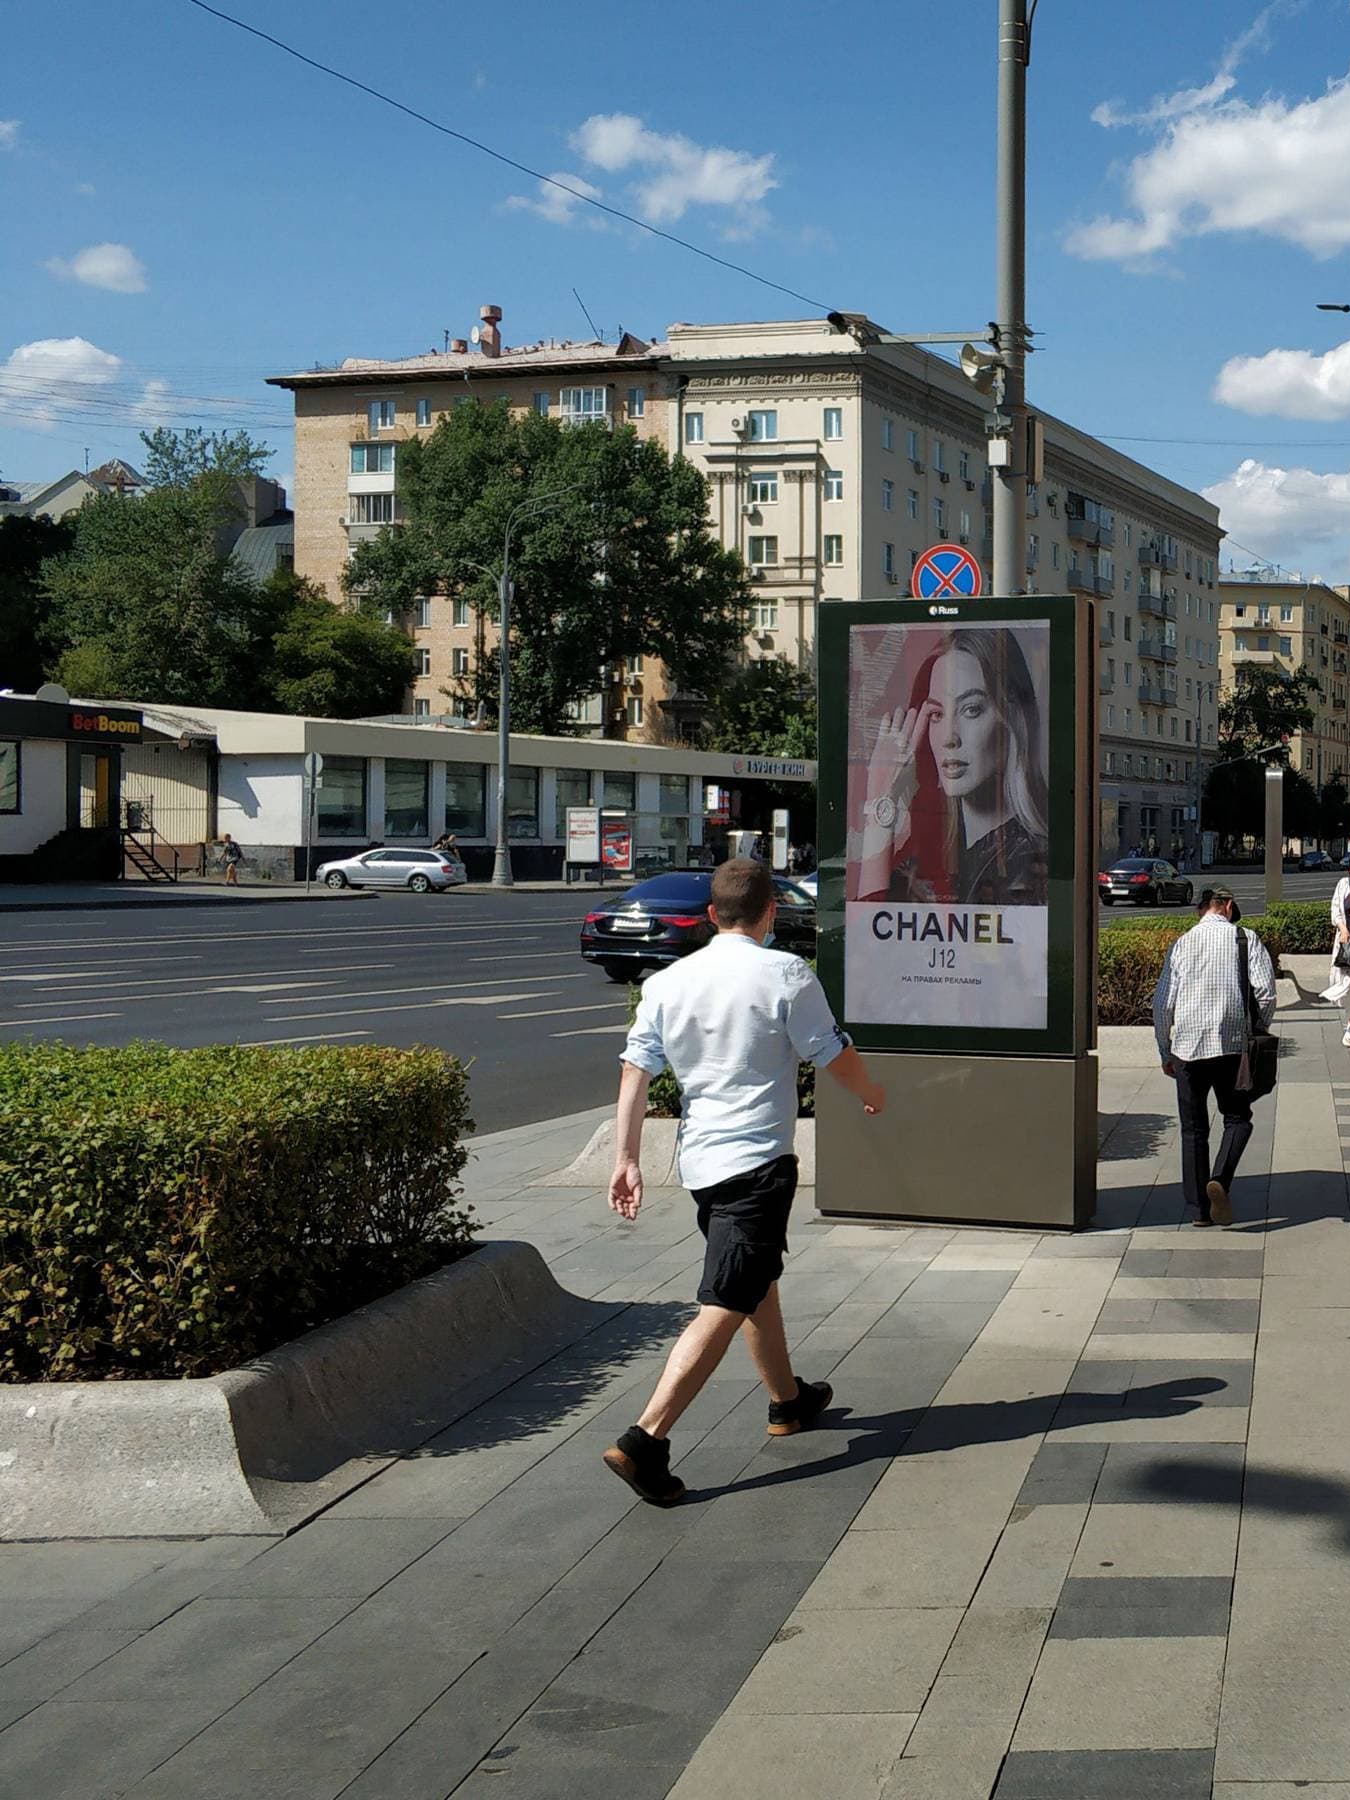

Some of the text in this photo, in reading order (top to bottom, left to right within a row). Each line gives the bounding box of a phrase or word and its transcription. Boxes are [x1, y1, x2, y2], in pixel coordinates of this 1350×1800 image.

[938, 606, 959, 615] Russ
[72, 713, 140, 734] BetBoom
[872, 910, 1014, 944] CHANEL
[928, 947, 955, 969] J12
[901, 975, 982, 985] НА ПРАВАХ РЕКЛАМЫ
